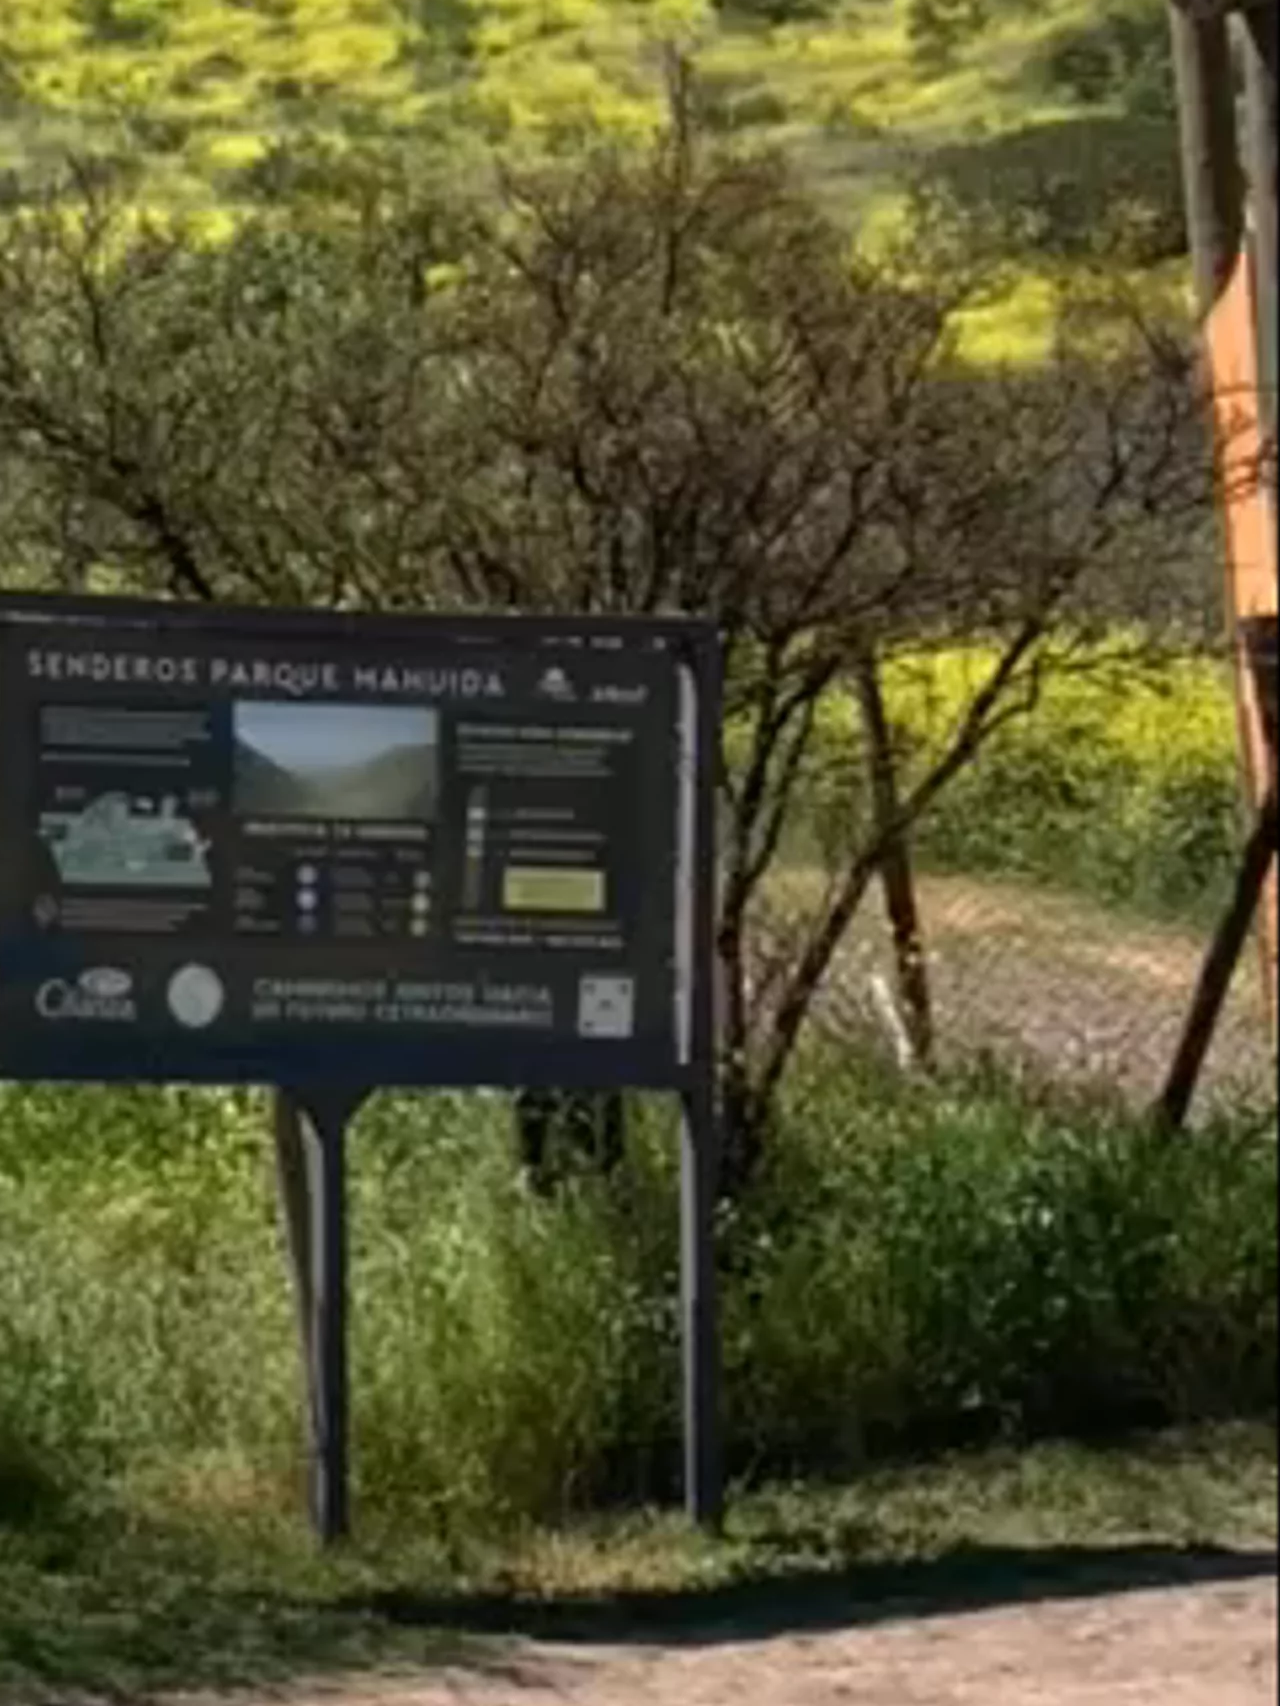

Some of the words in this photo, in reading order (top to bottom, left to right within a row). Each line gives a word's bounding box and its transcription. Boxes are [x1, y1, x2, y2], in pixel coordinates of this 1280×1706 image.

[27, 648, 198, 683] SENDEROS
[209, 658, 340, 696] PARQUE
[354, 667, 506, 698] MAHUIDA
